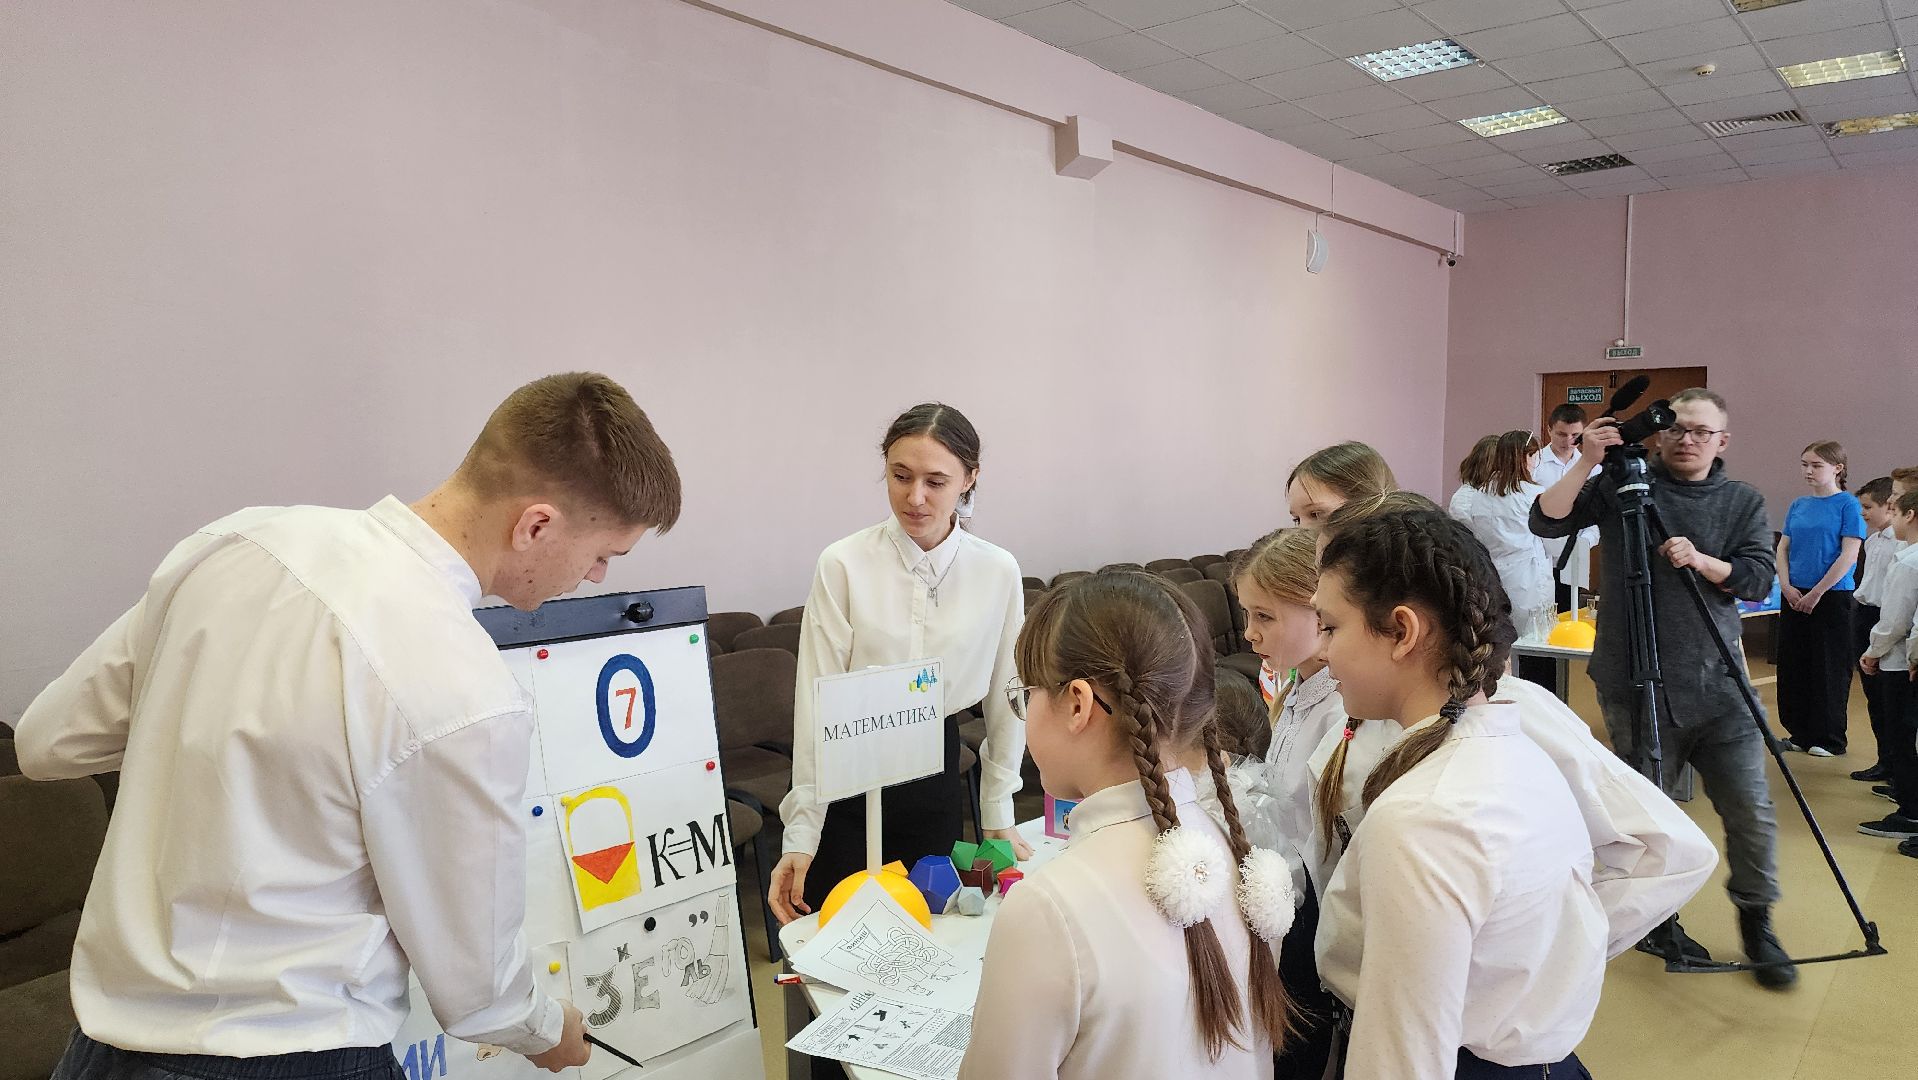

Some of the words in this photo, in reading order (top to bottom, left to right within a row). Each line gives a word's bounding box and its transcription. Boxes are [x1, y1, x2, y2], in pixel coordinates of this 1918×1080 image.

[1612, 348, 1638, 357] ВЫХОД
[1568, 393, 1602, 402] ВЫХОД
[616, 687, 637, 730] 7
[822, 704, 938, 742] МАТЕМАТИКА
